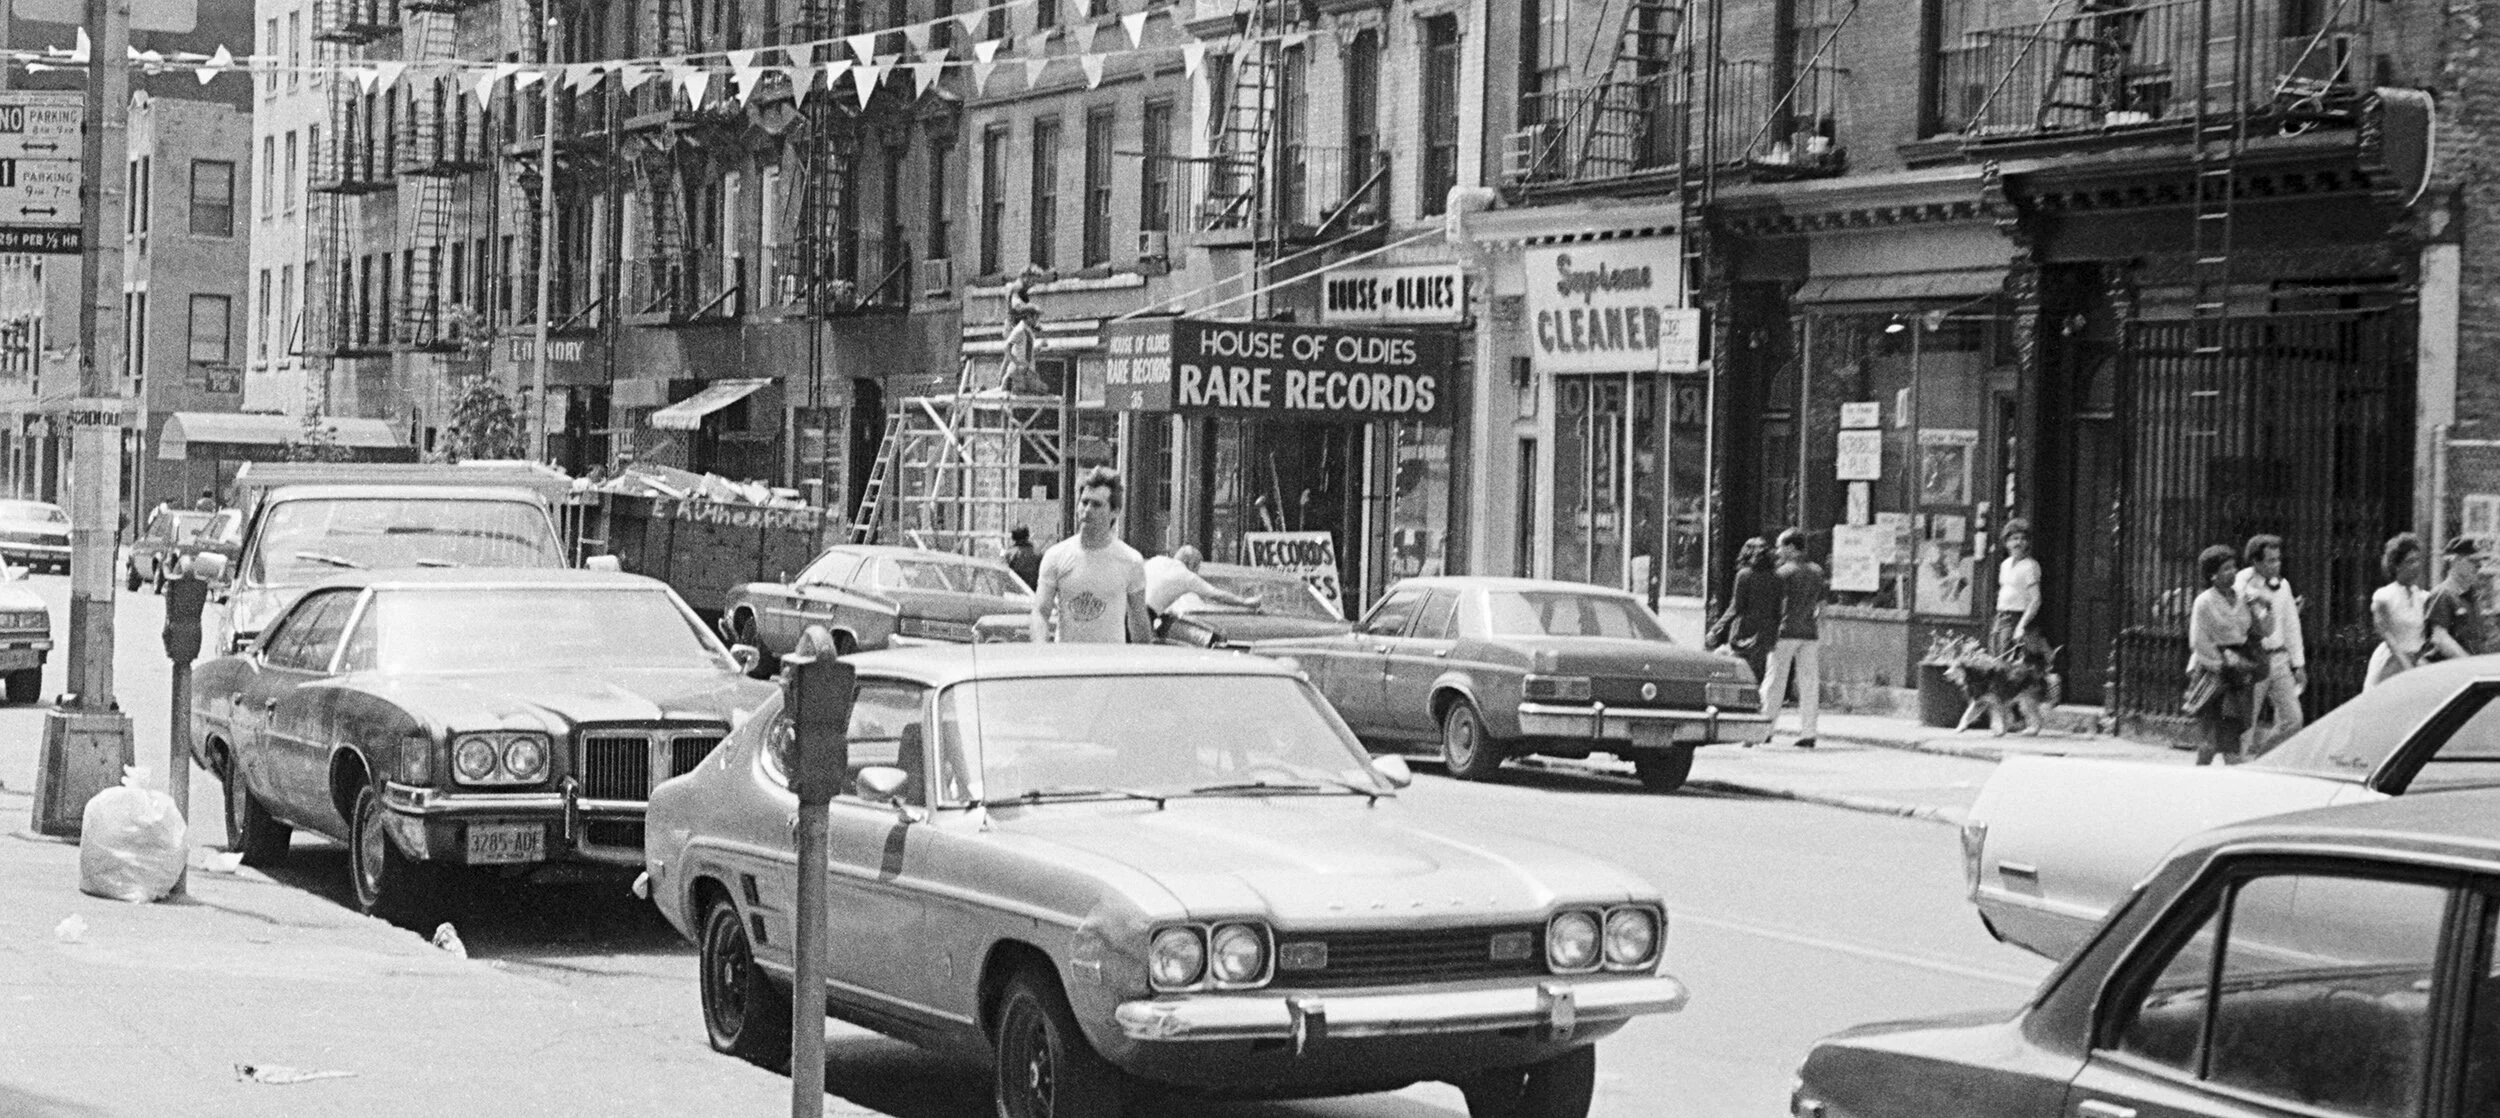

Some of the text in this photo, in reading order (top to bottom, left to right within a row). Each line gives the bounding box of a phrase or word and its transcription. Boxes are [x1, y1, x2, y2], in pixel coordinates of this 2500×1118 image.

[0, 107, 77, 130] NO PARKING
[23, 171, 73, 184] PARKING
[23, 233, 43, 246] PER
[62, 232, 78, 248] HR
[1556, 252, 1653, 306] Supreme
[1328, 276, 1378, 312] HOUSE
[1396, 275, 1454, 311] OLDIES
[1538, 305, 1674, 354] CLEANER
[513, 340, 585, 361] LANDRY
[1200, 329, 1417, 365] HOUSE OF OLDIES
[1106, 356, 1171, 385] RARE RECORDS
[1179, 363, 1436, 413] RARE RECORDS
[1252, 539, 1334, 567] RECORDS
[1301, 575, 1338, 601] ES
